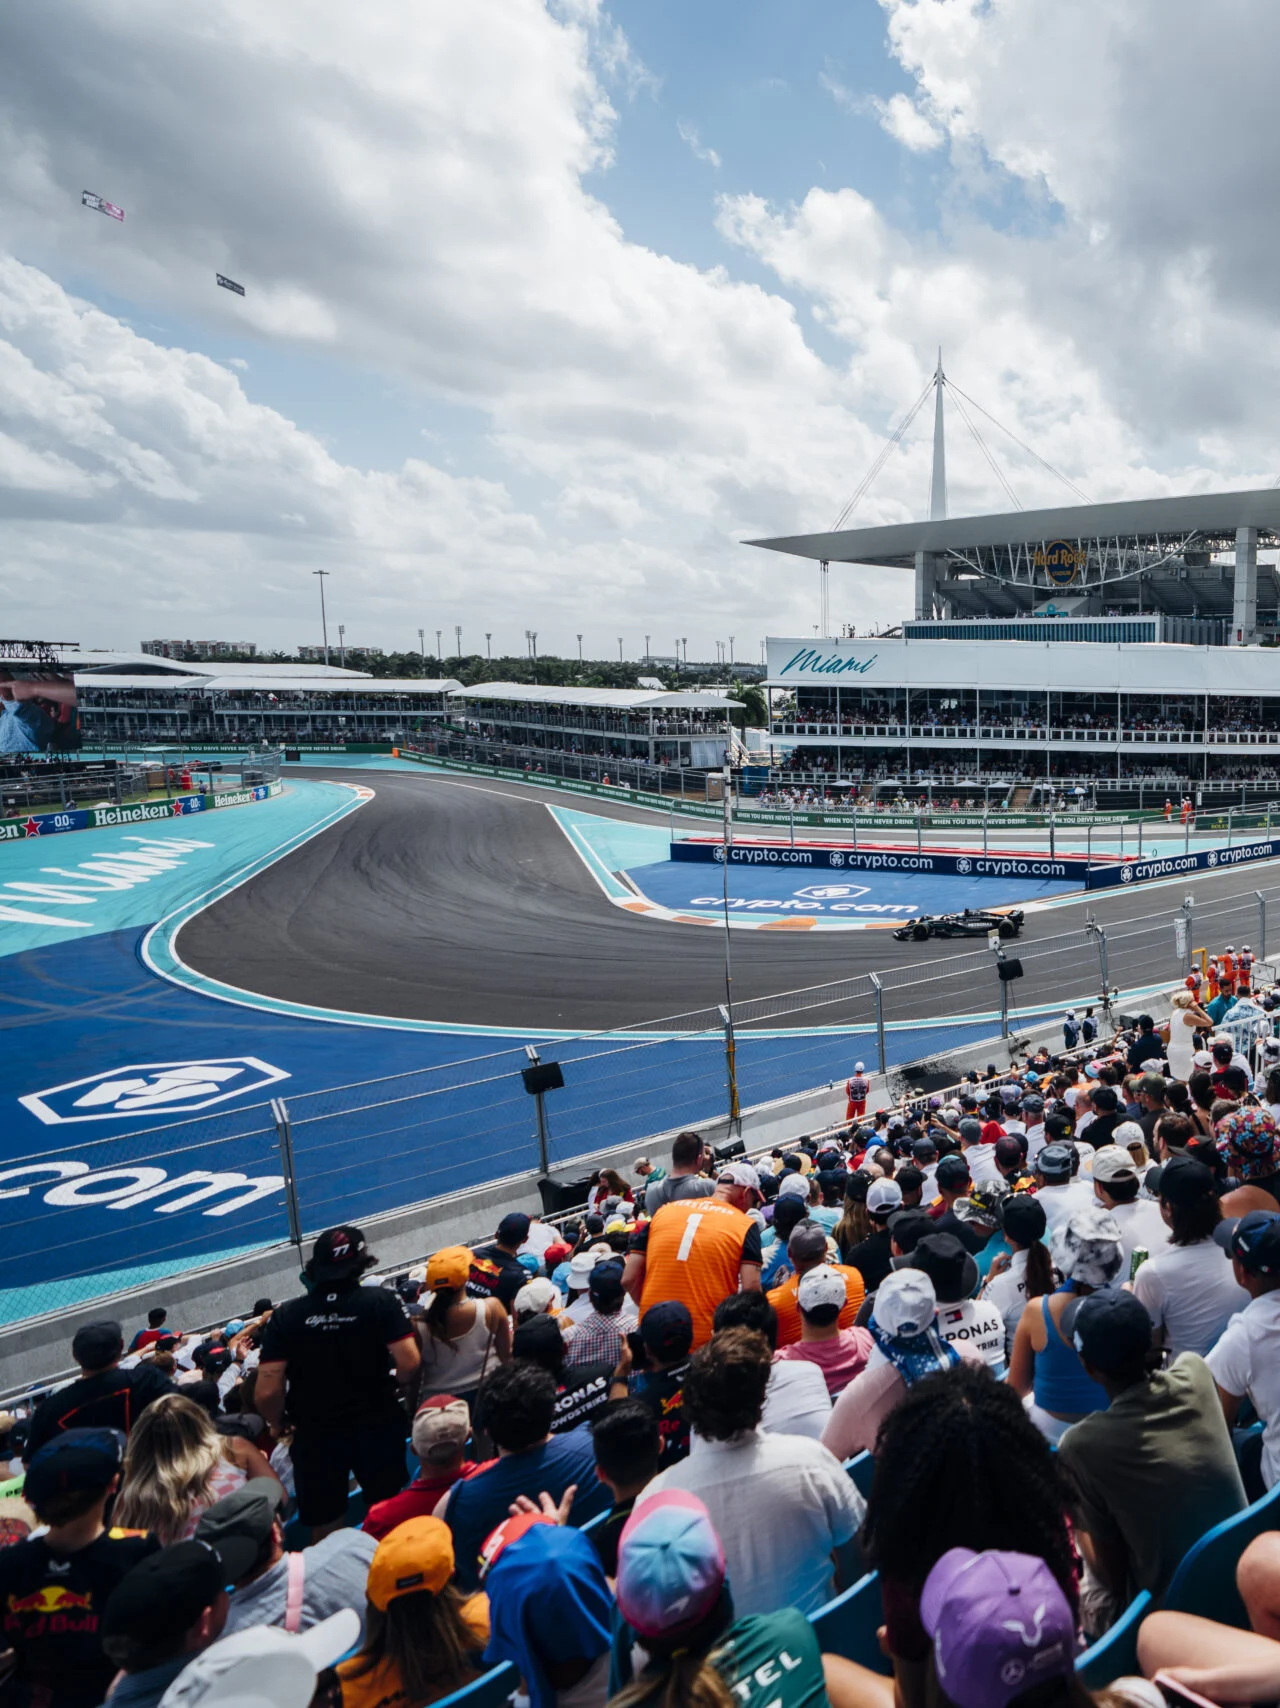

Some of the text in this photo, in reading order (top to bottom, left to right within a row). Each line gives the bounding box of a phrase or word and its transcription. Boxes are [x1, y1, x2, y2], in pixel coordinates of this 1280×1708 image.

[1033, 549, 1086, 567] Hard Rock
[780, 648, 878, 676] Miami
[214, 791, 250, 807] Heineken
[95, 800, 169, 825] Heineken
[731, 849, 812, 863] crypto.com
[849, 854, 933, 868] crypto.com
[1220, 843, 1272, 862] crypto.com
[976, 860, 1065, 875] crypto.com
[1136, 855, 1197, 877] crypto.com
[690, 896, 919, 914] crypto.com
[676, 1213, 703, 1261] 1
[332, 1244, 350, 1256] 77
[50, 1615, 98, 1634] Bull
